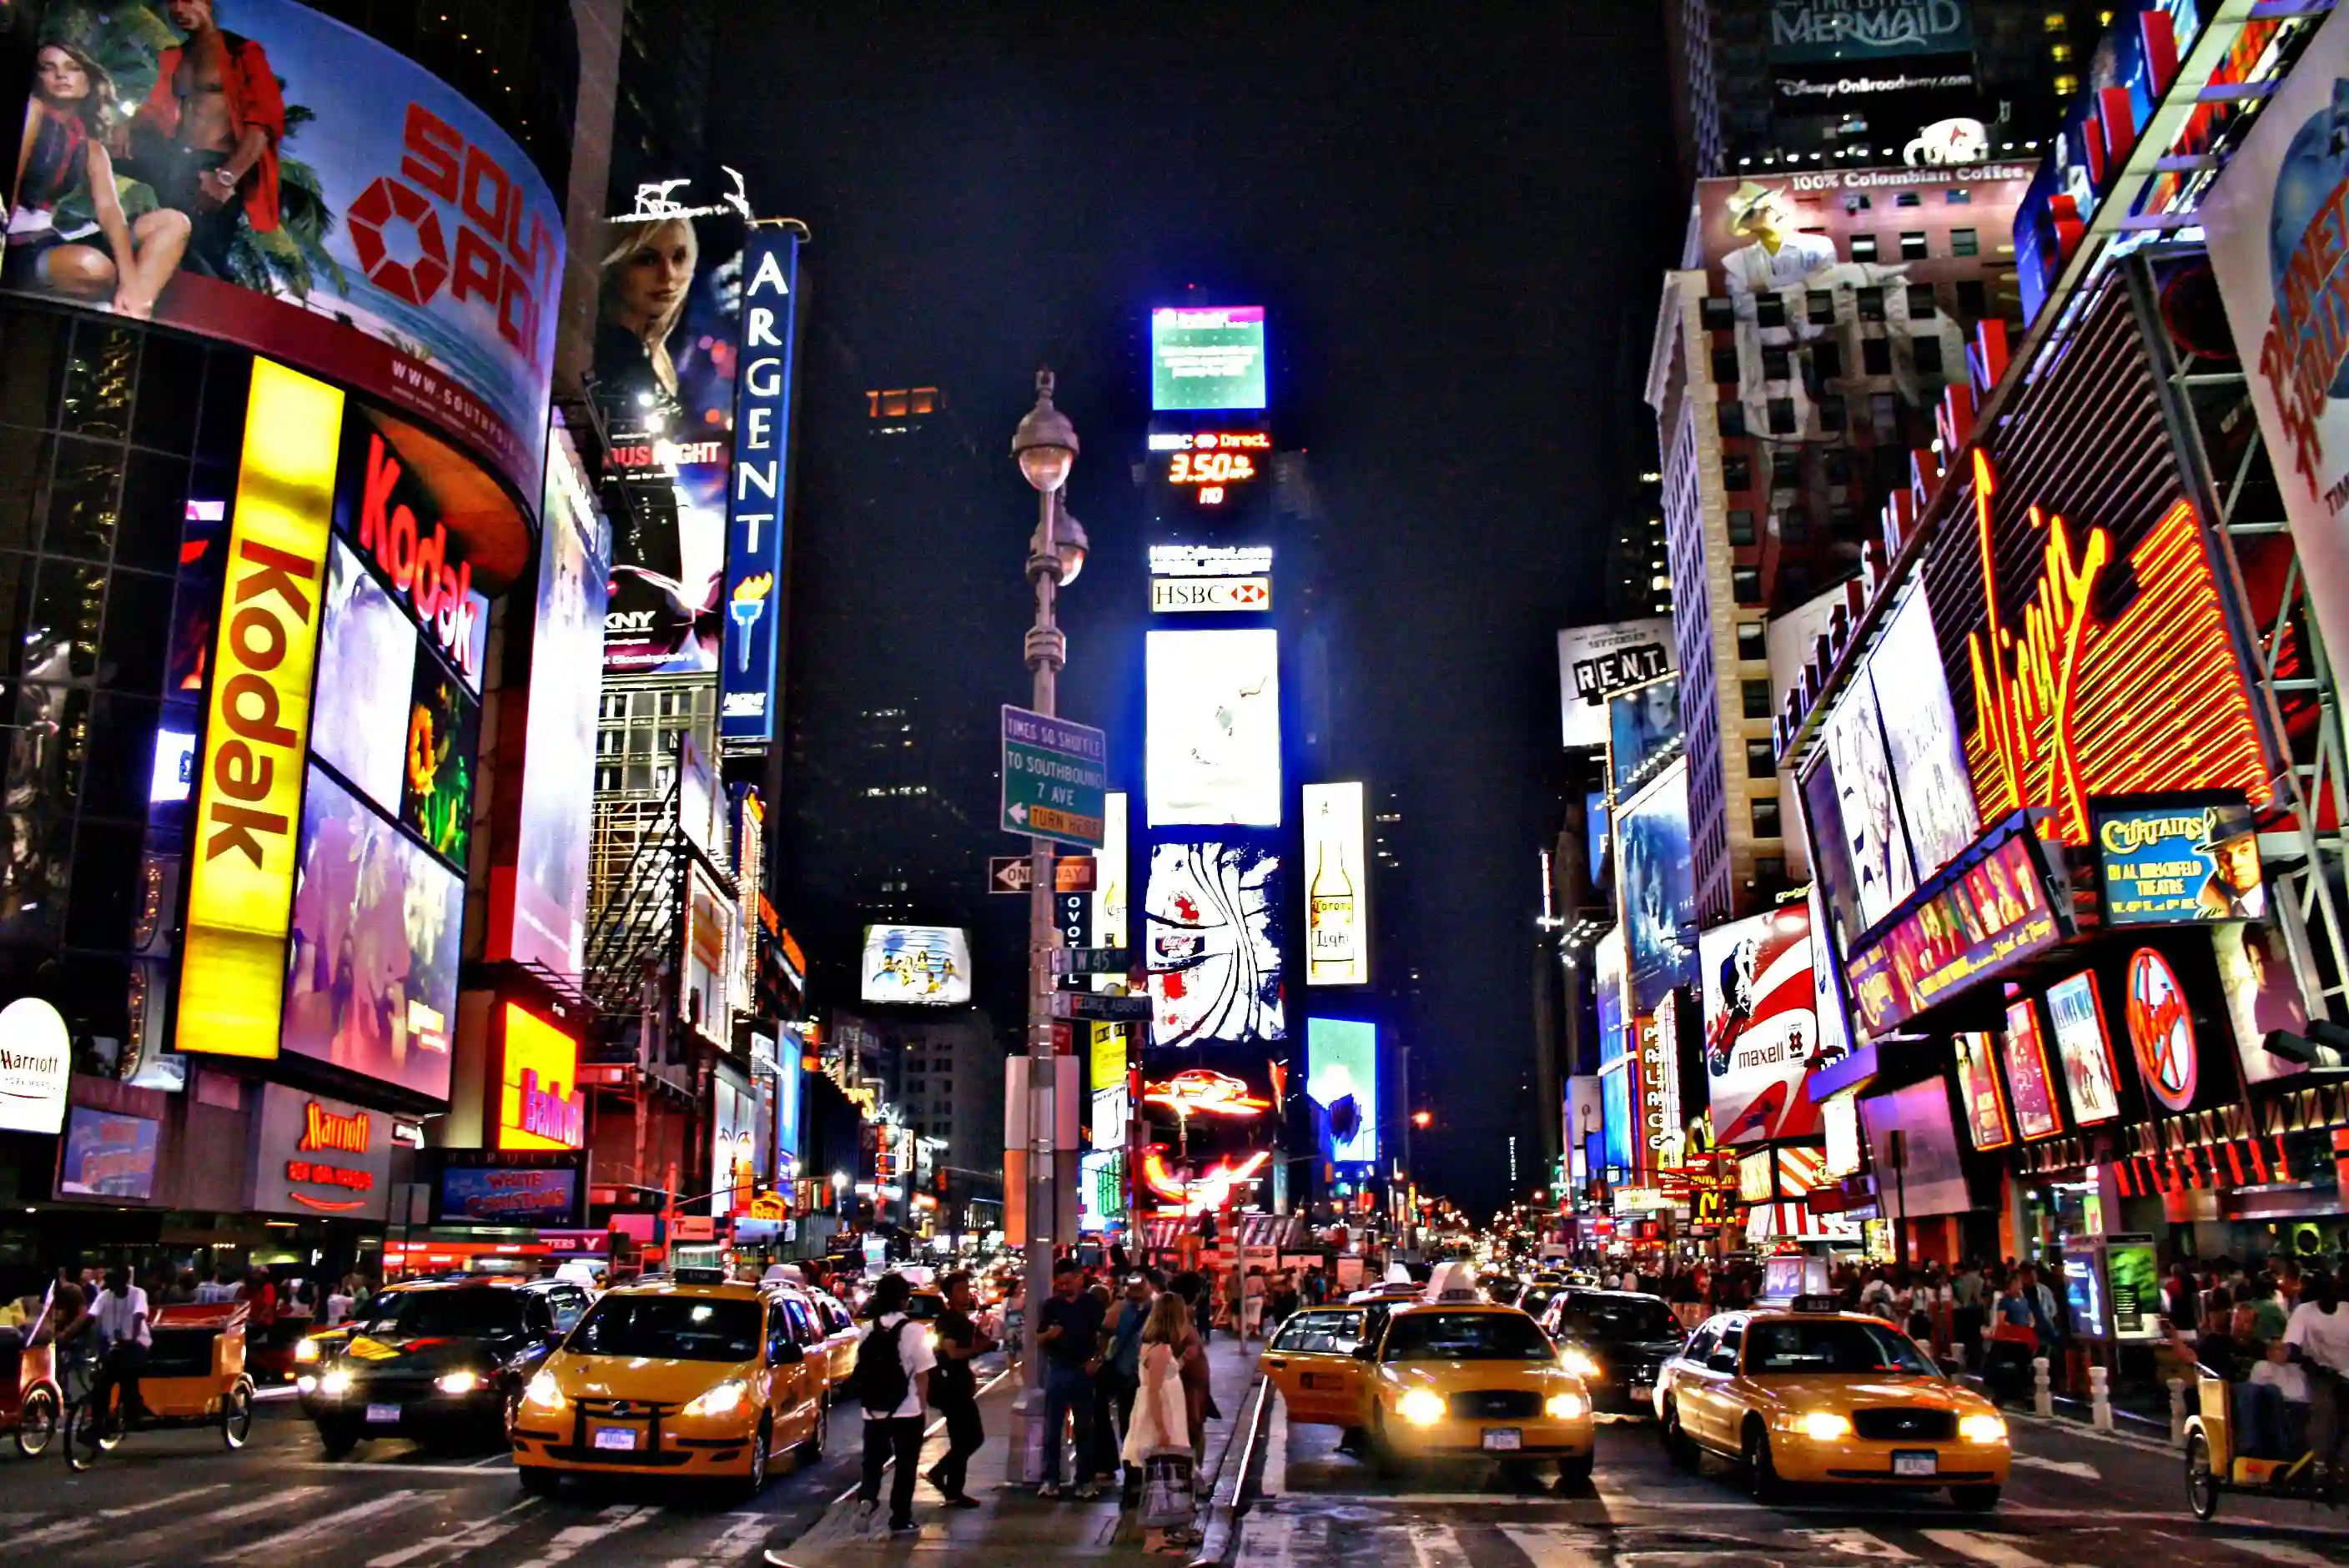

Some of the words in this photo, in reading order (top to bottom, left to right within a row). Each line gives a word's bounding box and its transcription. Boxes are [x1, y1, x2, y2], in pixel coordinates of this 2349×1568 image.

[1772, 0, 1960, 45] MERMAID
[1793, 173, 1839, 191] 100%
[1844, 170, 1950, 188] Colombian
[736, 250, 788, 553] ARGENT
[652, 441, 722, 465] NGHT
[361, 432, 478, 676] Kodak
[1156, 585, 1224, 605] HSBC
[1577, 650, 1660, 691] RENT
[205, 538, 316, 871] Kodak
[1008, 717, 1038, 741] TIMES
[1041, 726, 1055, 746] SQ
[1058, 731, 1102, 757] SHUTTLE
[1007, 751, 1023, 770] TO
[1027, 756, 1104, 790] SOUTHBOUND
[1037, 781, 1044, 798] 7
[1051, 787, 1075, 806] AVE
[1032, 807, 1064, 830] TURN
[1076, 952, 1087, 971] W
[1093, 950, 1109, 972] 45
[1738, 1041, 1784, 1069] maxell
[299, 1100, 370, 1153] Marriott
